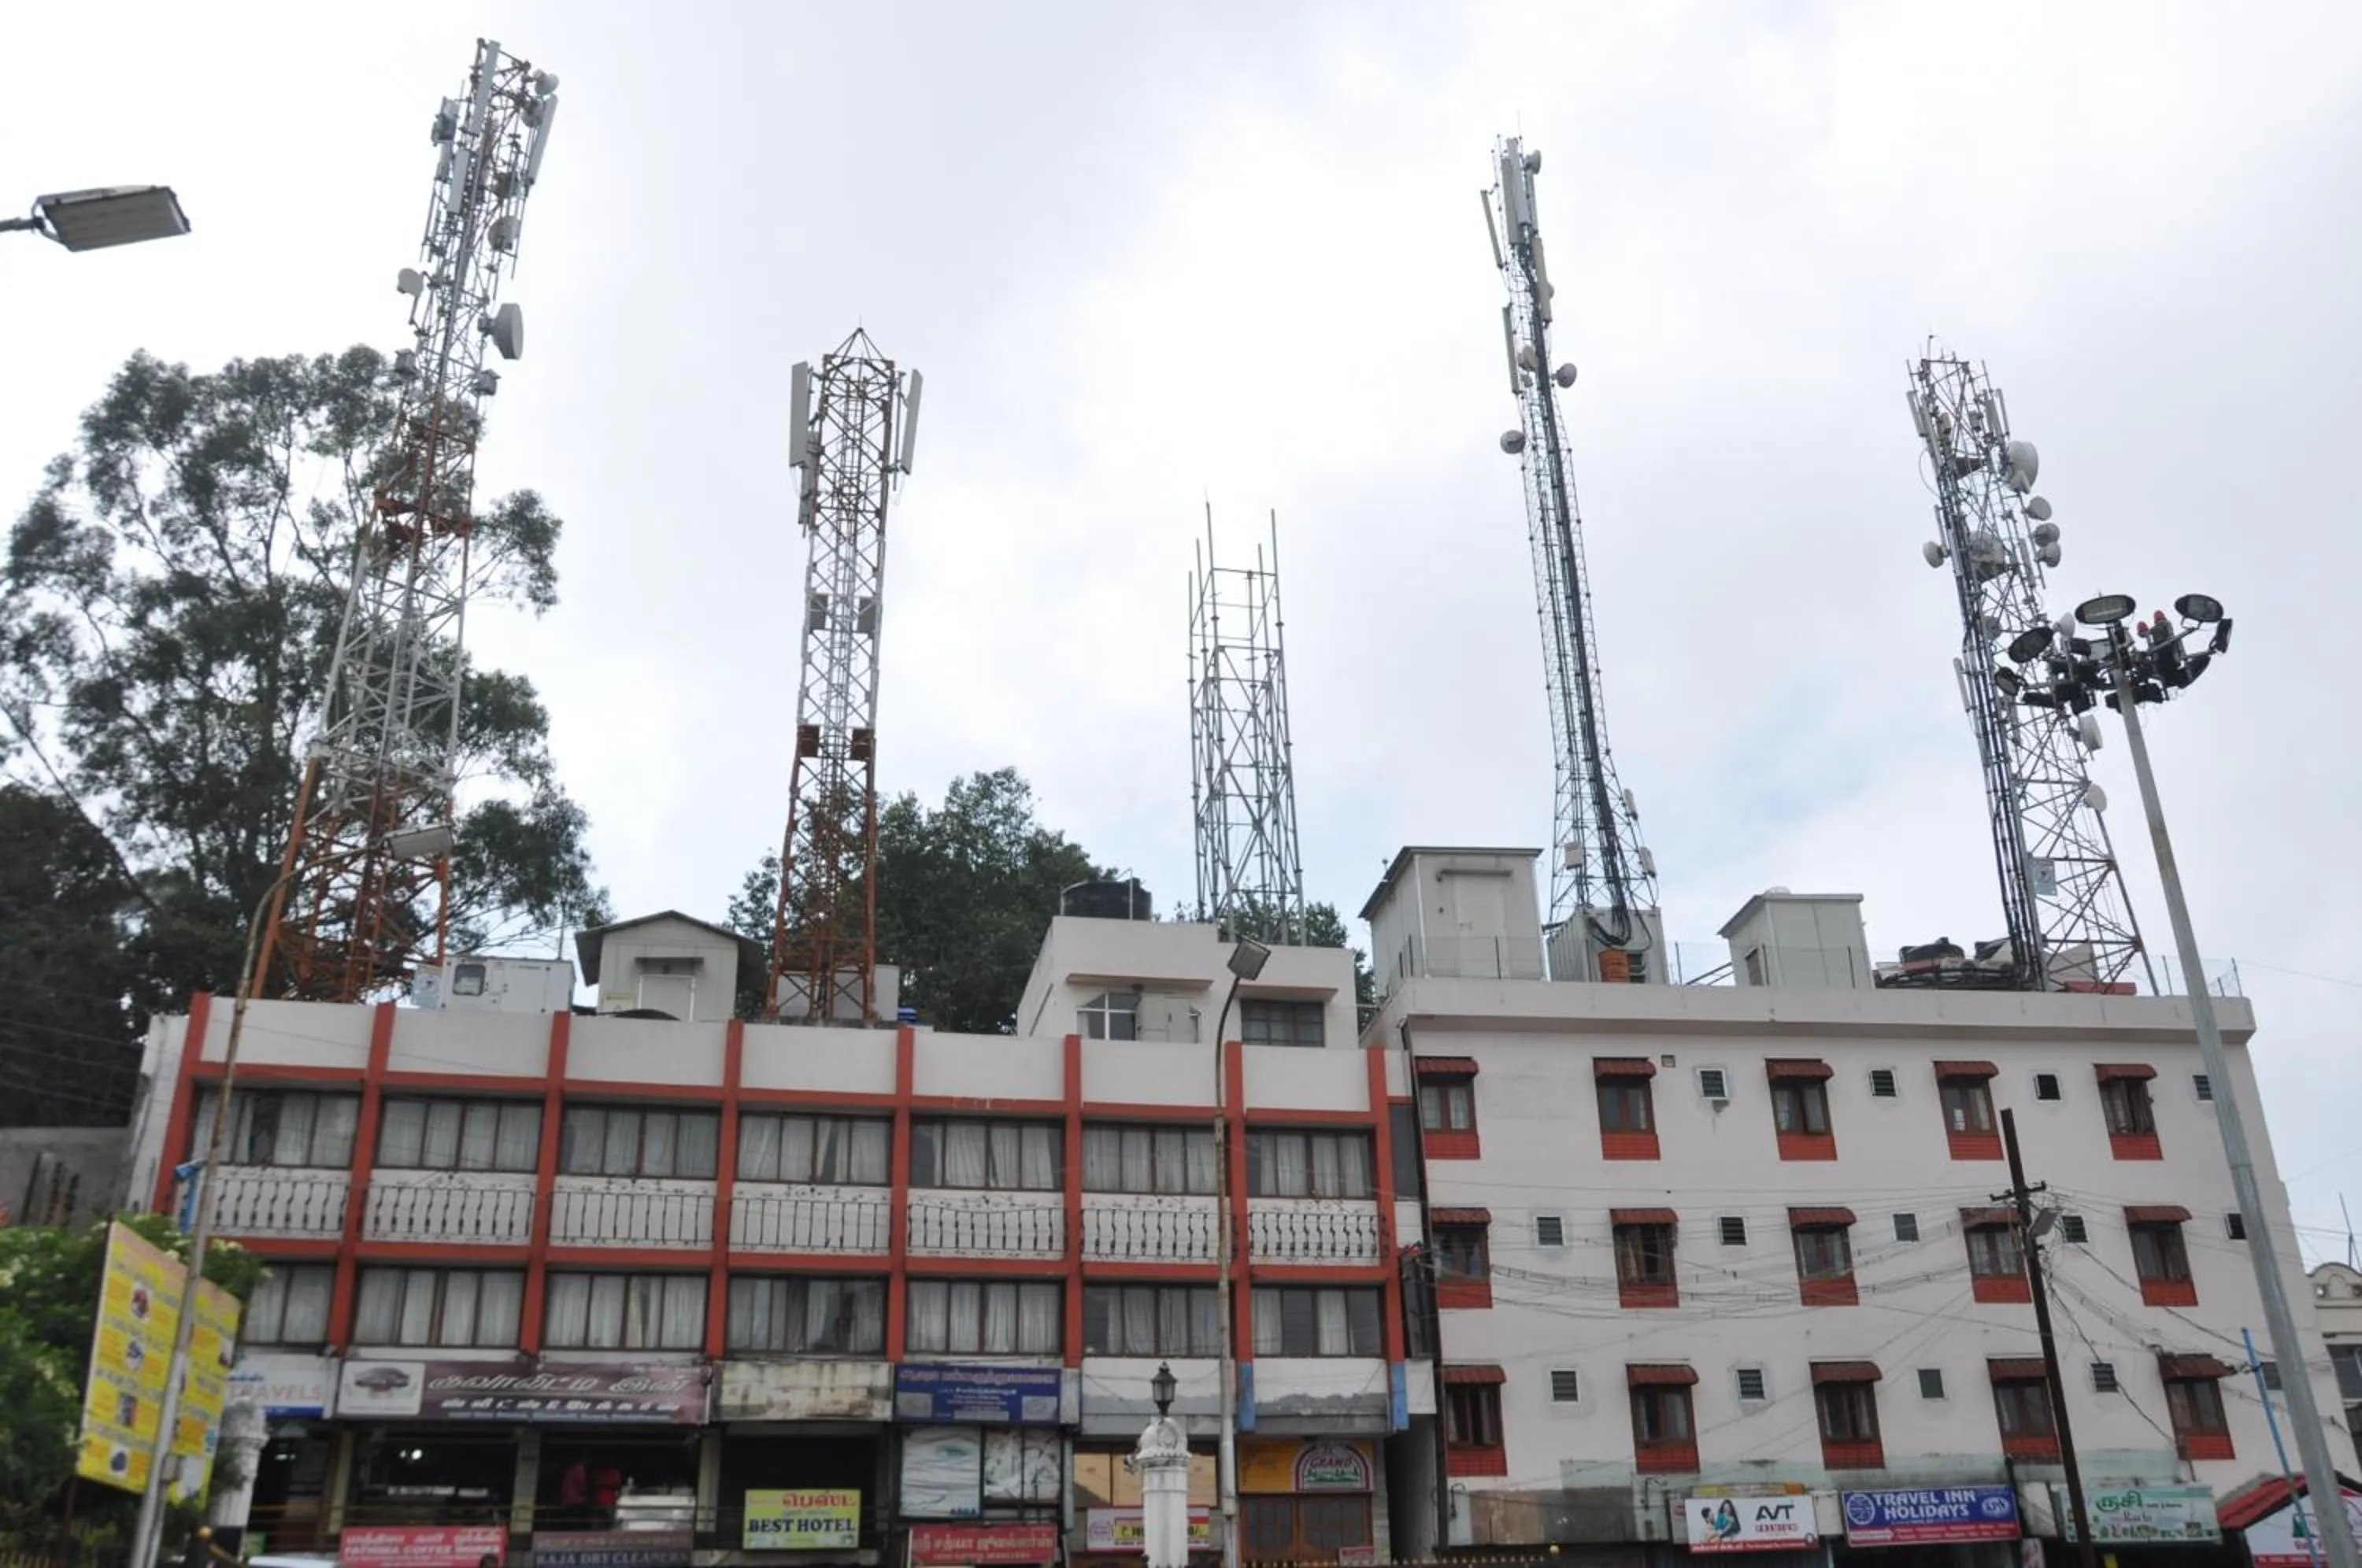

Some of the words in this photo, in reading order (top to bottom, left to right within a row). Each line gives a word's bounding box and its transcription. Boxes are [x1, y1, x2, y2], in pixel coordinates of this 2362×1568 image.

[1871, 1491, 1939, 1507] TRAVEL
[1945, 1490, 1979, 1503] INN
[1755, 1504, 1795, 1521] AVT
[1884, 1503, 1969, 1520] HOLIDAYS
[749, 1518, 794, 1533] BEST
[797, 1518, 856, 1533] HOTEL
[580, 1551, 608, 1563] DRY
